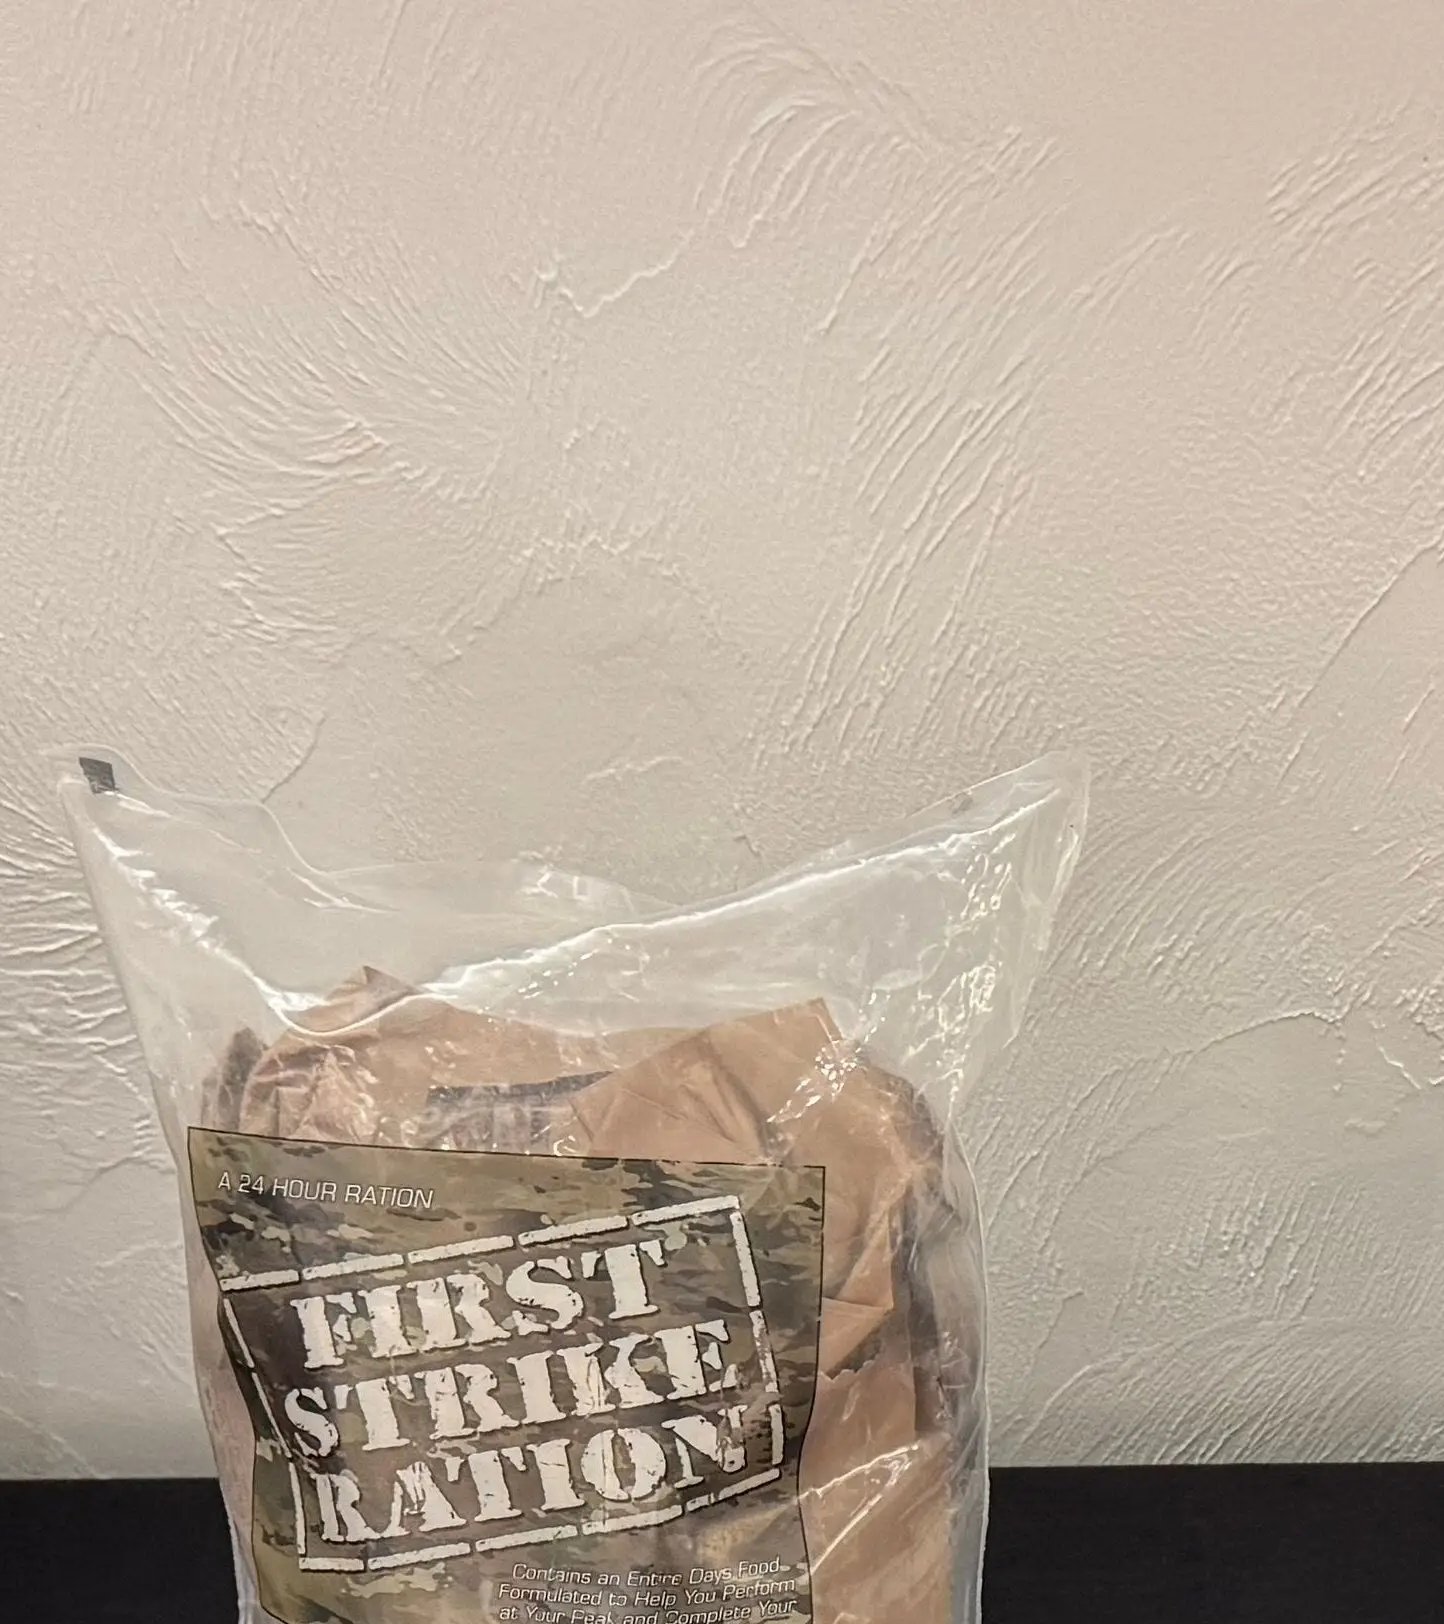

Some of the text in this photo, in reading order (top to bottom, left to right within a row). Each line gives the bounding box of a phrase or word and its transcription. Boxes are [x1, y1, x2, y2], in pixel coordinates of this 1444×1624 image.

[217, 1171, 434, 1209] A 24 HOUR RATION
[288, 1236, 668, 1371] FIRST
[282, 1317, 741, 1460] STRIKE
[313, 1402, 748, 1545] RATION
[512, 1563, 591, 1585] Contains
[596, 1570, 620, 1587] an
[689, 1567, 733, 1586] Days
[738, 1556, 781, 1578] Food
[498, 1579, 796, 1610] Formulated to Help You Perform
[499, 1606, 519, 1621] at
[526, 1606, 566, 1624] Your
[757, 1598, 798, 1619] Your
